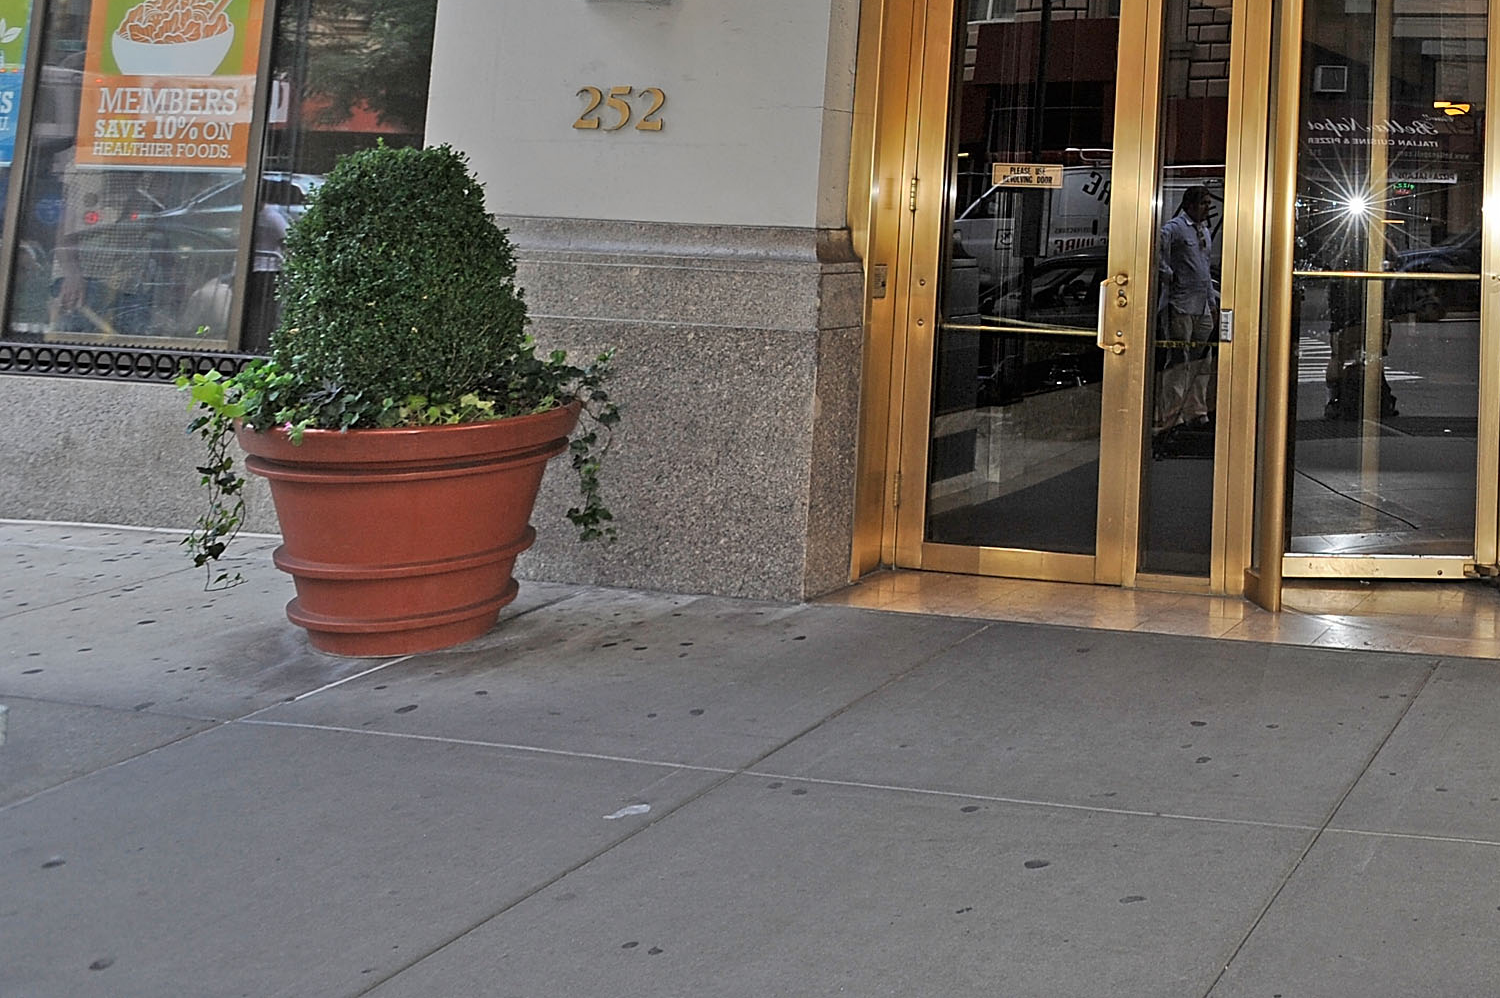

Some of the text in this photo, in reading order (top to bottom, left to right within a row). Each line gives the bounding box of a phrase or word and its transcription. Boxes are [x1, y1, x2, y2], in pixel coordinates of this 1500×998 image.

[97, 87, 239, 116] MEMBERS
[572, 86, 665, 131] 252
[94, 116, 235, 140] SAVE 10% ON
[93, 141, 232, 159] HEALTHIER FOODS.
[1010, 166, 1031, 175] PLEASE
[1037, 175, 1053, 184] DOOR
